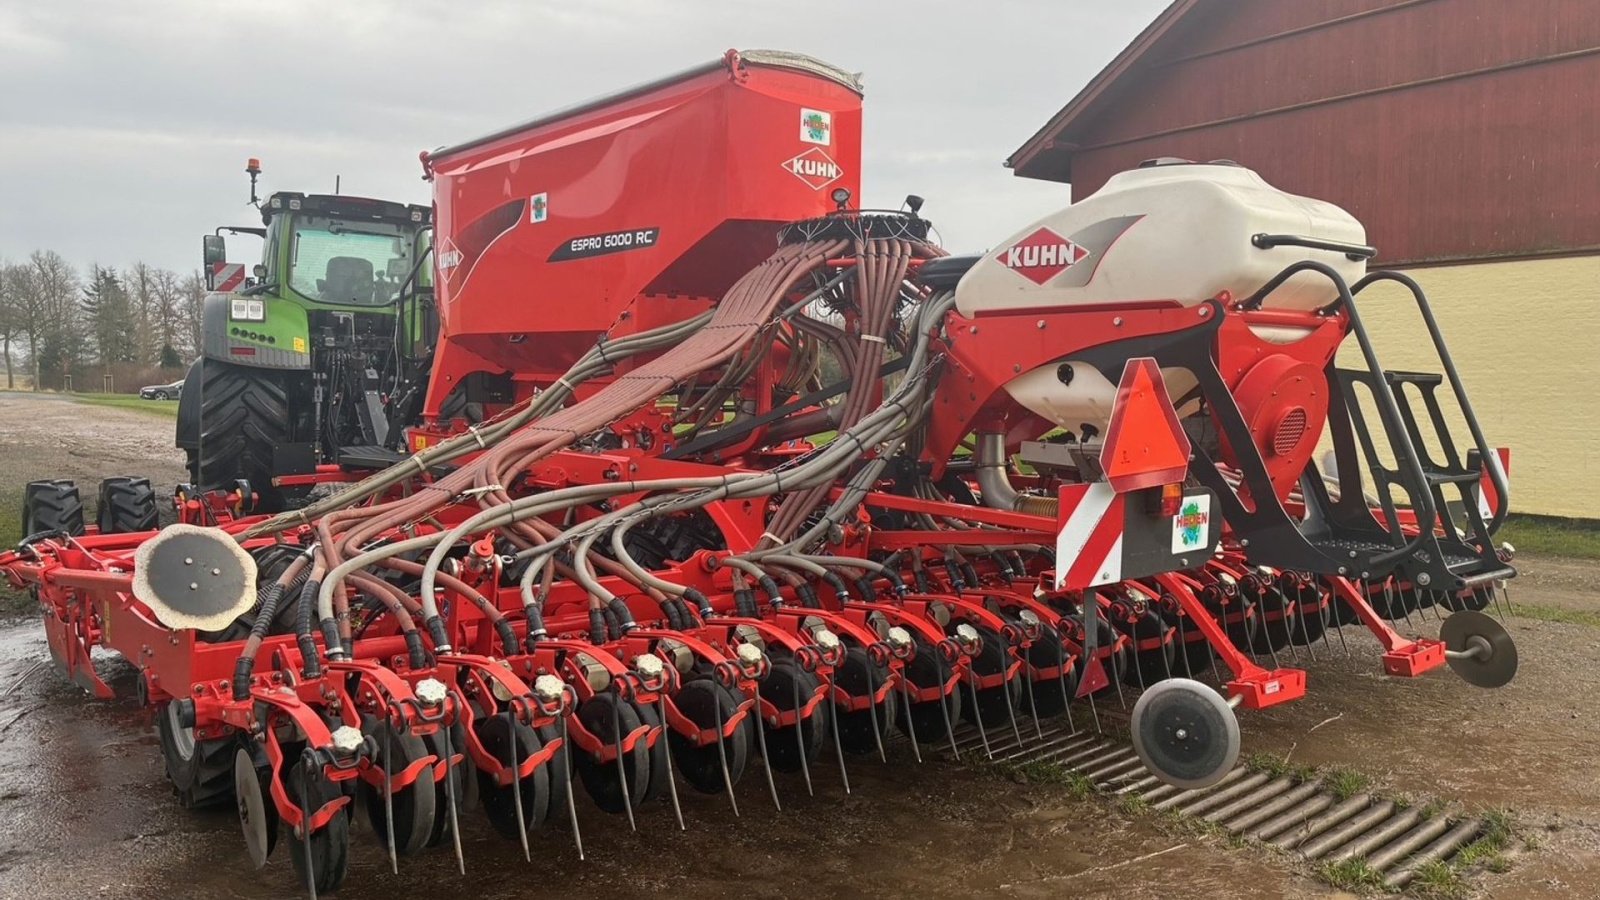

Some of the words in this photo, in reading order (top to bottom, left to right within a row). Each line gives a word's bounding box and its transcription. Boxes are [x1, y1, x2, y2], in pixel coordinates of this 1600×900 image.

[793, 158, 836, 179] KUHN
[571, 237, 601, 251] ESPRO
[604, 233, 632, 248] 6000
[636, 230, 653, 245] RC
[1007, 243, 1076, 268] KUHN
